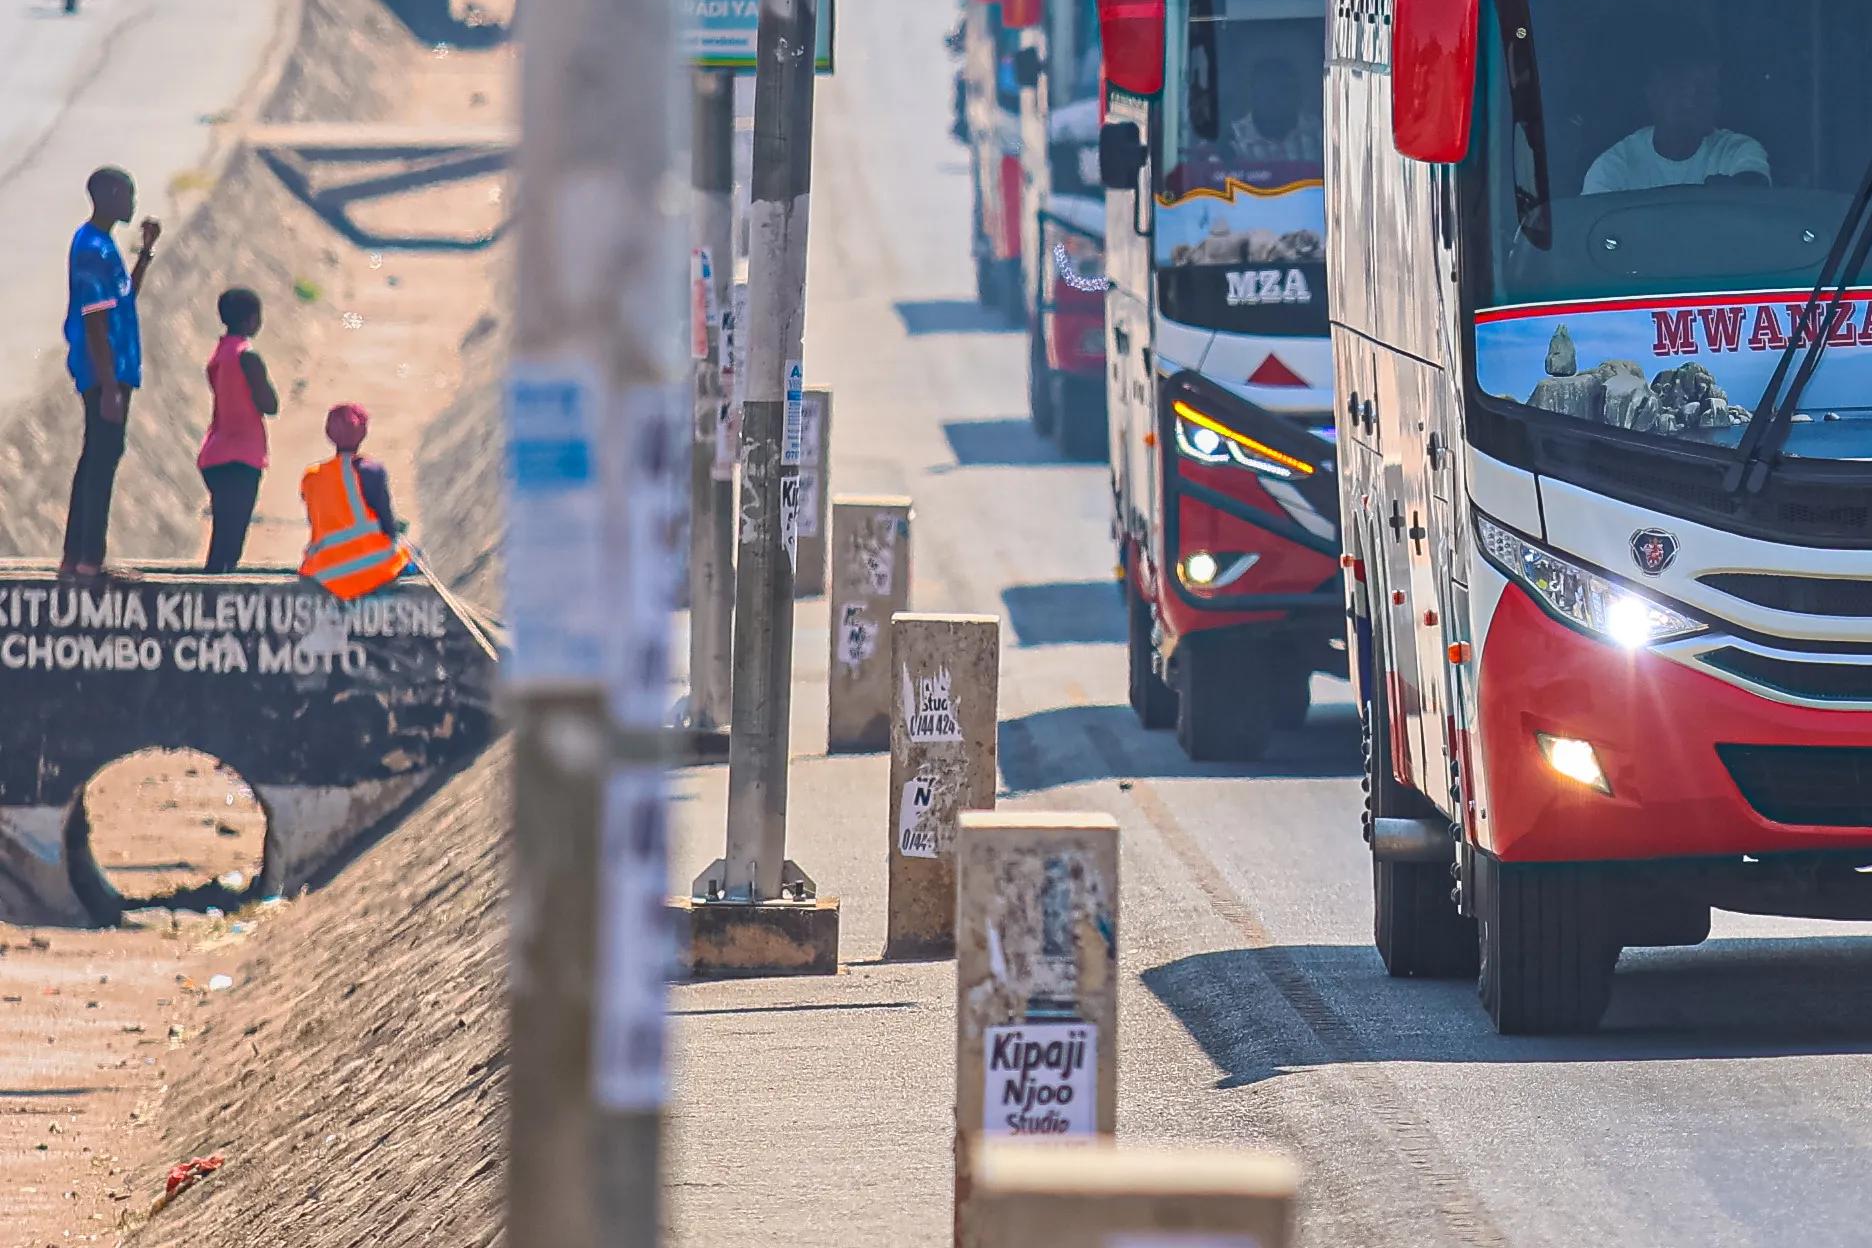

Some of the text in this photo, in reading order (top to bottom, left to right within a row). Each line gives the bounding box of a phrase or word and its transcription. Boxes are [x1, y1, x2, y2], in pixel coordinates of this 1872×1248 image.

[1225, 268, 1312, 305] MZA
[156, 589, 266, 635] KILEVI
[2, 632, 163, 671] CHOMBO
[173, 631, 248, 674] CHA
[990, 1030, 1087, 1089] Kipaji
[1002, 1077, 1073, 1113] Njoo
[1006, 1110, 1071, 1136] Studio
